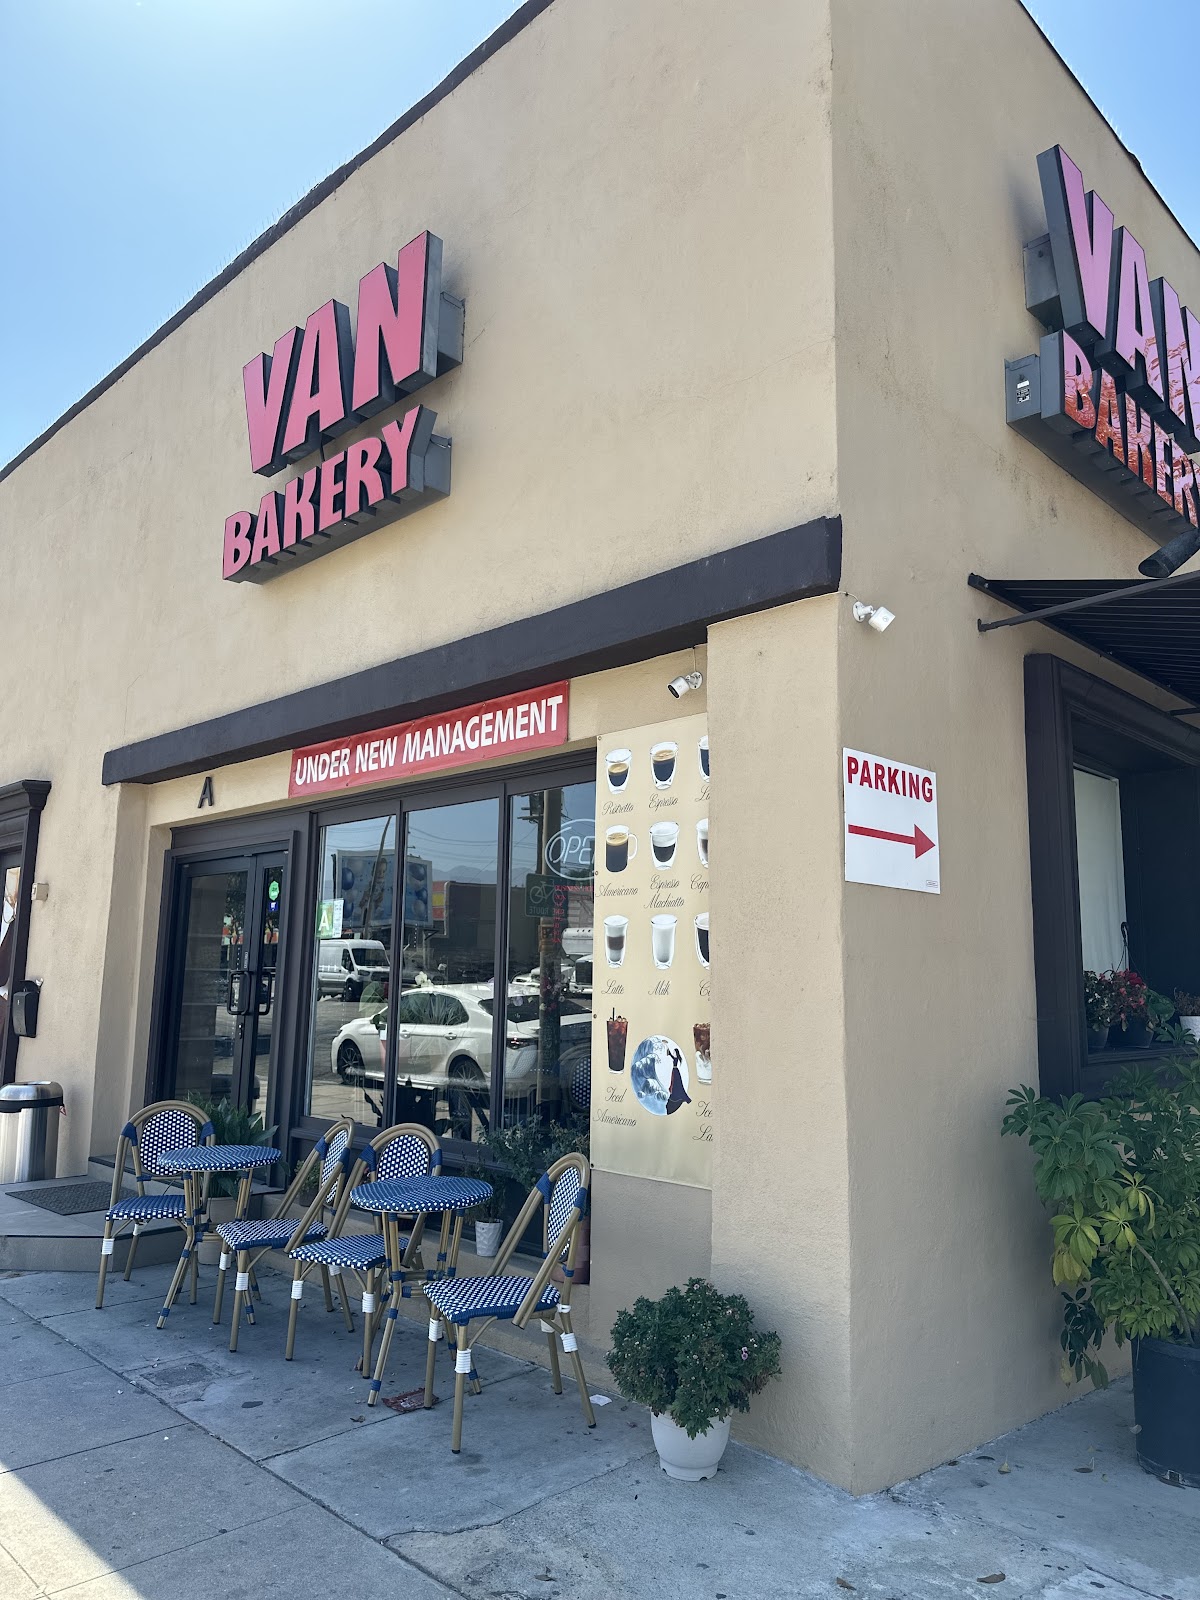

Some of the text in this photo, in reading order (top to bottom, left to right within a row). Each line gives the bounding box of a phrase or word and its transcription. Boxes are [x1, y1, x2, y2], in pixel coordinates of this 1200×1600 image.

[1058, 144, 1200, 434] VAN
[243, 230, 428, 474] VAN
[1063, 330, 1200, 529] BAKER
[223, 404, 422, 580] BAKERY
[294, 695, 563, 786] UNDER NEW MANAGEMENT
[847, 756, 933, 803] PARKING
[197, 776, 214, 809] A
[649, 793, 679, 812] Espresso
[602, 801, 634, 815] Ristretto
[550, 836, 595, 864] OPE
[595, 883, 639, 898] Americano
[650, 874, 680, 893] Espresso
[318, 910, 330, 931] A
[601, 979, 625, 995] Latte
[648, 980, 671, 996] Milk
[605, 1086, 627, 1103] Iced
[592, 1108, 637, 1127] Americano
